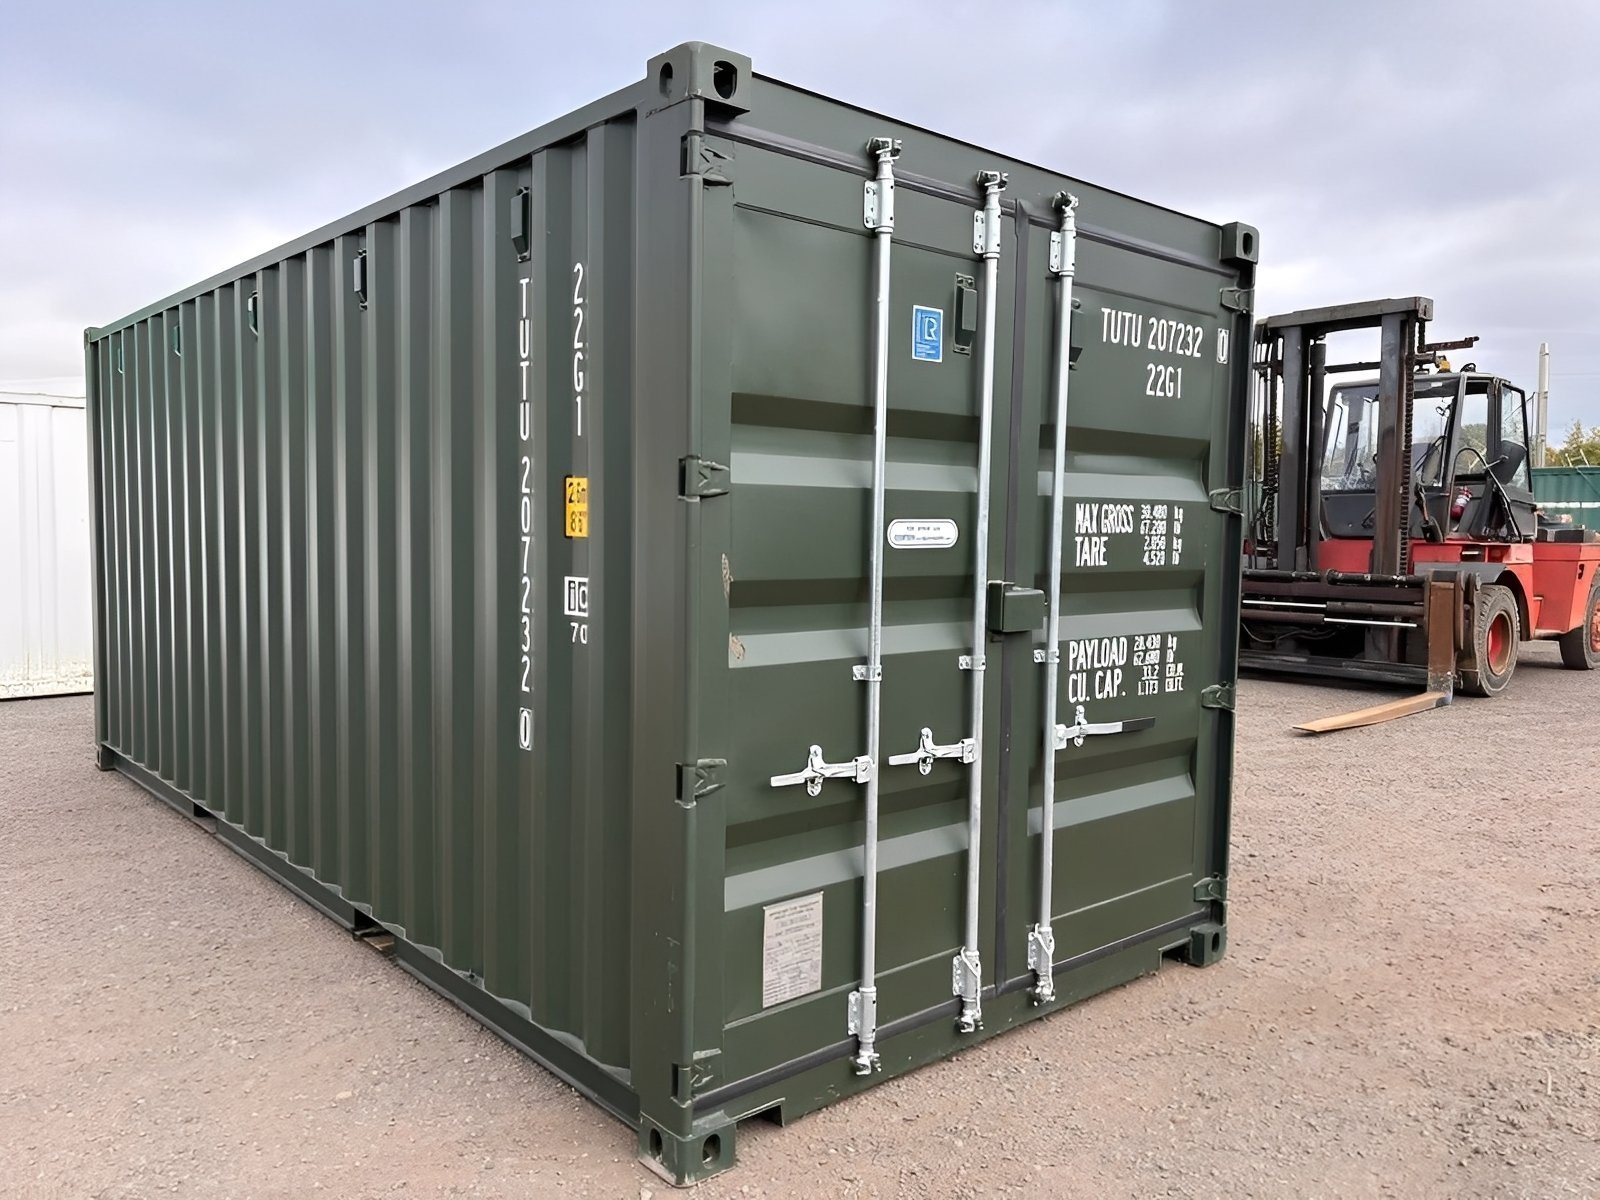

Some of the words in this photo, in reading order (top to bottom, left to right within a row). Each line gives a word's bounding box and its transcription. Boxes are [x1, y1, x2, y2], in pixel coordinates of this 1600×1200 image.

[573, 262, 584, 437] 22G1
[1101, 307, 1143, 348] TUTU
[1147, 317, 1204, 358] 207232
[1217, 328, 1229, 364] 0
[519, 278, 530, 441] TUTU
[1146, 363, 1182, 399] 22G1
[1075, 503, 1099, 534] MAX
[1101, 503, 1135, 534] GROSS
[1075, 536, 1109, 567] TARE
[521, 455, 531, 692] 207232
[1068, 636, 1128, 671] PAYLOAD
[1068, 672, 1091, 703] CU.
[1095, 668, 1127, 699] CAP.
[520, 708, 532, 750] 0
